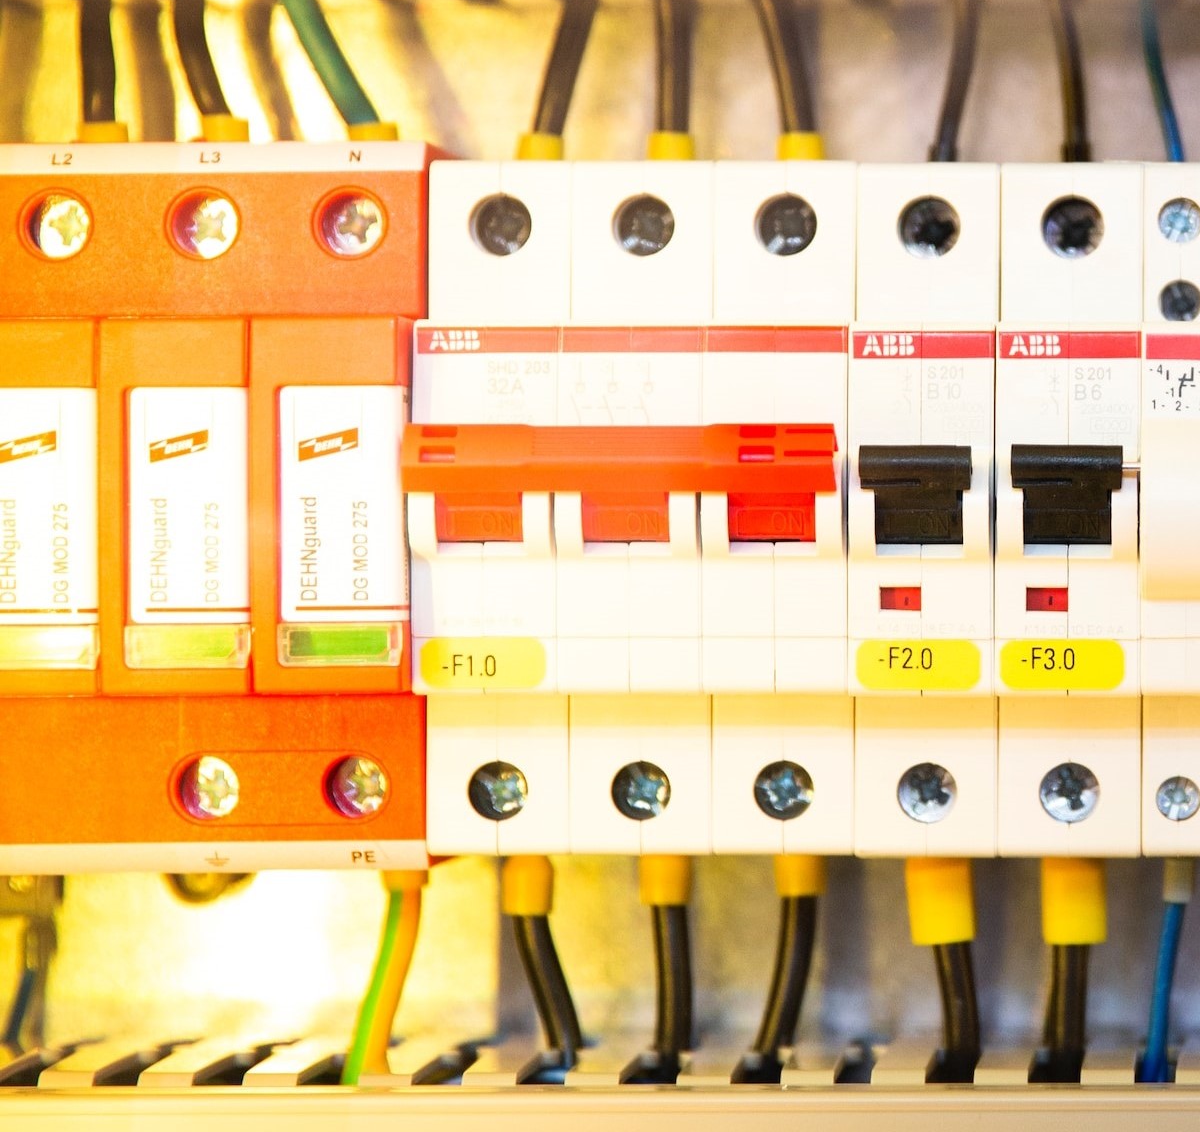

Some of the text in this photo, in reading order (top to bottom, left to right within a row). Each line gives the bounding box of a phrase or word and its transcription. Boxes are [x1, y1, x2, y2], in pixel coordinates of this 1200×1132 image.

[50, 152, 73, 166] L2
[199, 151, 221, 165] L3
[349, 150, 362, 163] N
[429, 330, 481, 350] ABB
[862, 335, 915, 356] ABB
[1008, 335, 1061, 356] ABB
[52, 502, 69, 532] 275
[52, 536, 69, 574] MOD
[150, 496, 173, 603] DEHNguard
[203, 502, 221, 604] DG MOD 275
[299, 496, 322, 602] DEHNguard
[351, 500, 369, 601] DG MOD 275
[441, 654, 497, 677] -F1.0
[879, 646, 933, 670] -F2.0
[1021, 647, 1075, 671] -F3.0
[351, 850, 377, 864] PE
